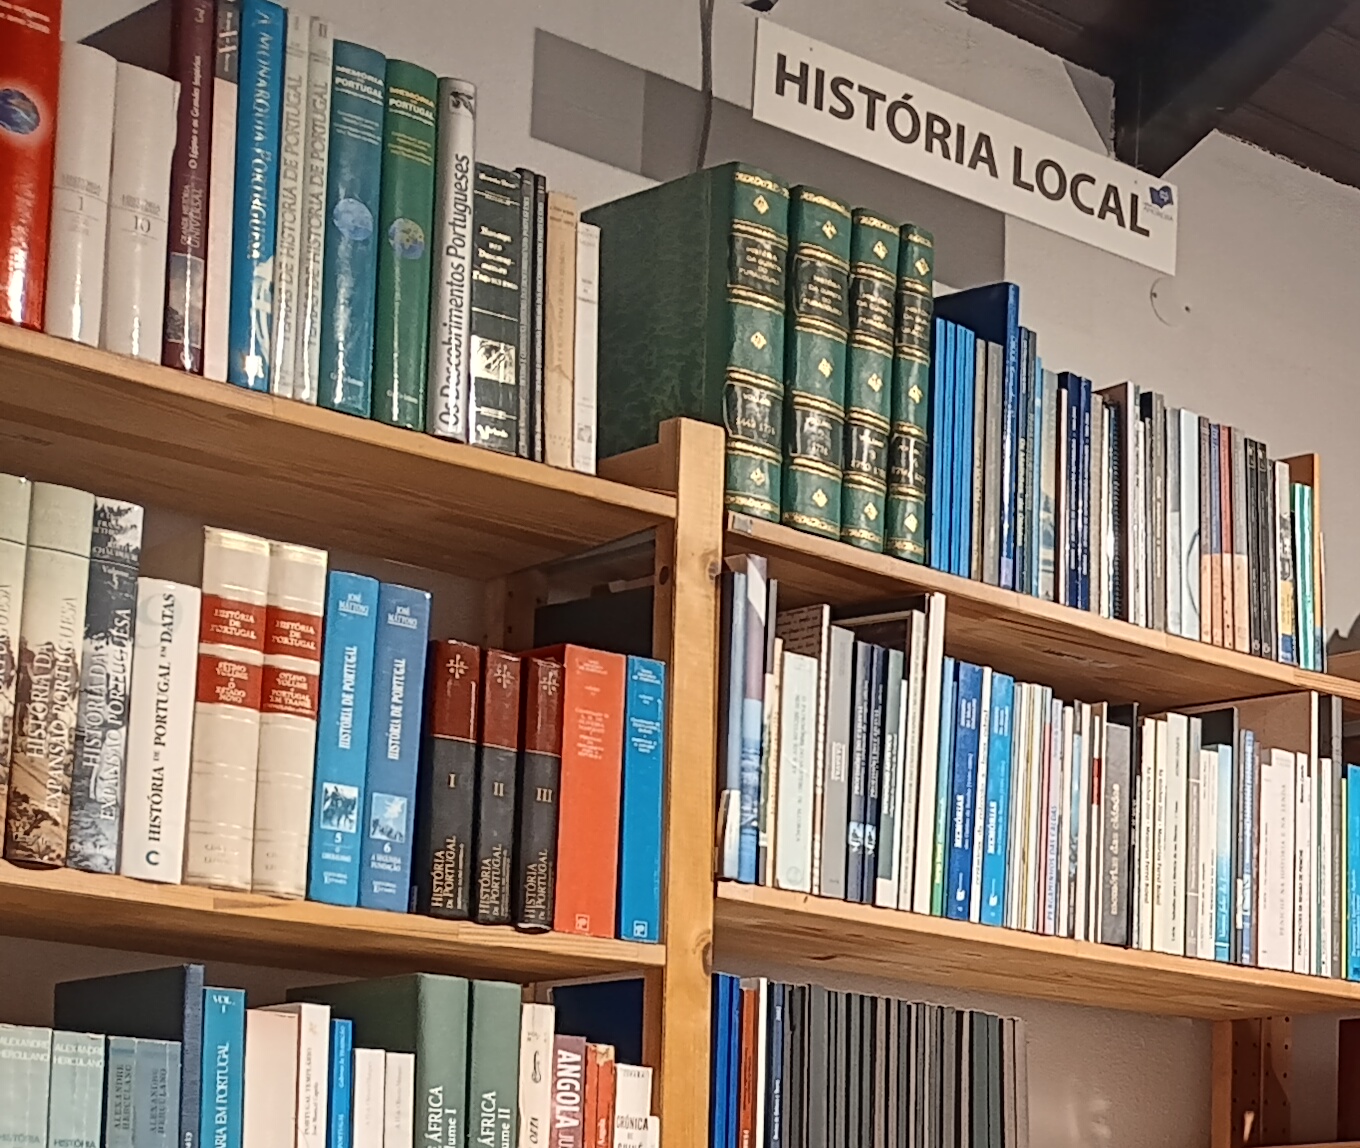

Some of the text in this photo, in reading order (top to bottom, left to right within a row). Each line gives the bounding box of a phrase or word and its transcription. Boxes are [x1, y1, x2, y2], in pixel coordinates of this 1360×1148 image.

[335, 77, 384, 100] PORTUGAL
[389, 98, 435, 120] PORTUGAL
[774, 52, 1150, 237] HISTÓRIA LOCAL
[439, 154, 474, 434] Os Descobrimentos Portugueses
[160, 592, 176, 644] DATAS
[153, 662, 171, 748] PORTUGAL
[147, 766, 165, 843] HISTÓRIA
[431, 850, 445, 908] HISTÓRIA
[444, 835, 457, 898] PORTUGAL
[217, 1042, 229, 1108] PORTUGAL
[555, 1050, 582, 1129] ANGOLA
[215, 1110, 227, 1131] EM
[427, 1085, 443, 1142] ÁFRICA
[480, 1090, 496, 1146] ÁFRICA
[500, 1107, 511, 1120] II
[617, 1115, 649, 1131] CRÓNICA
